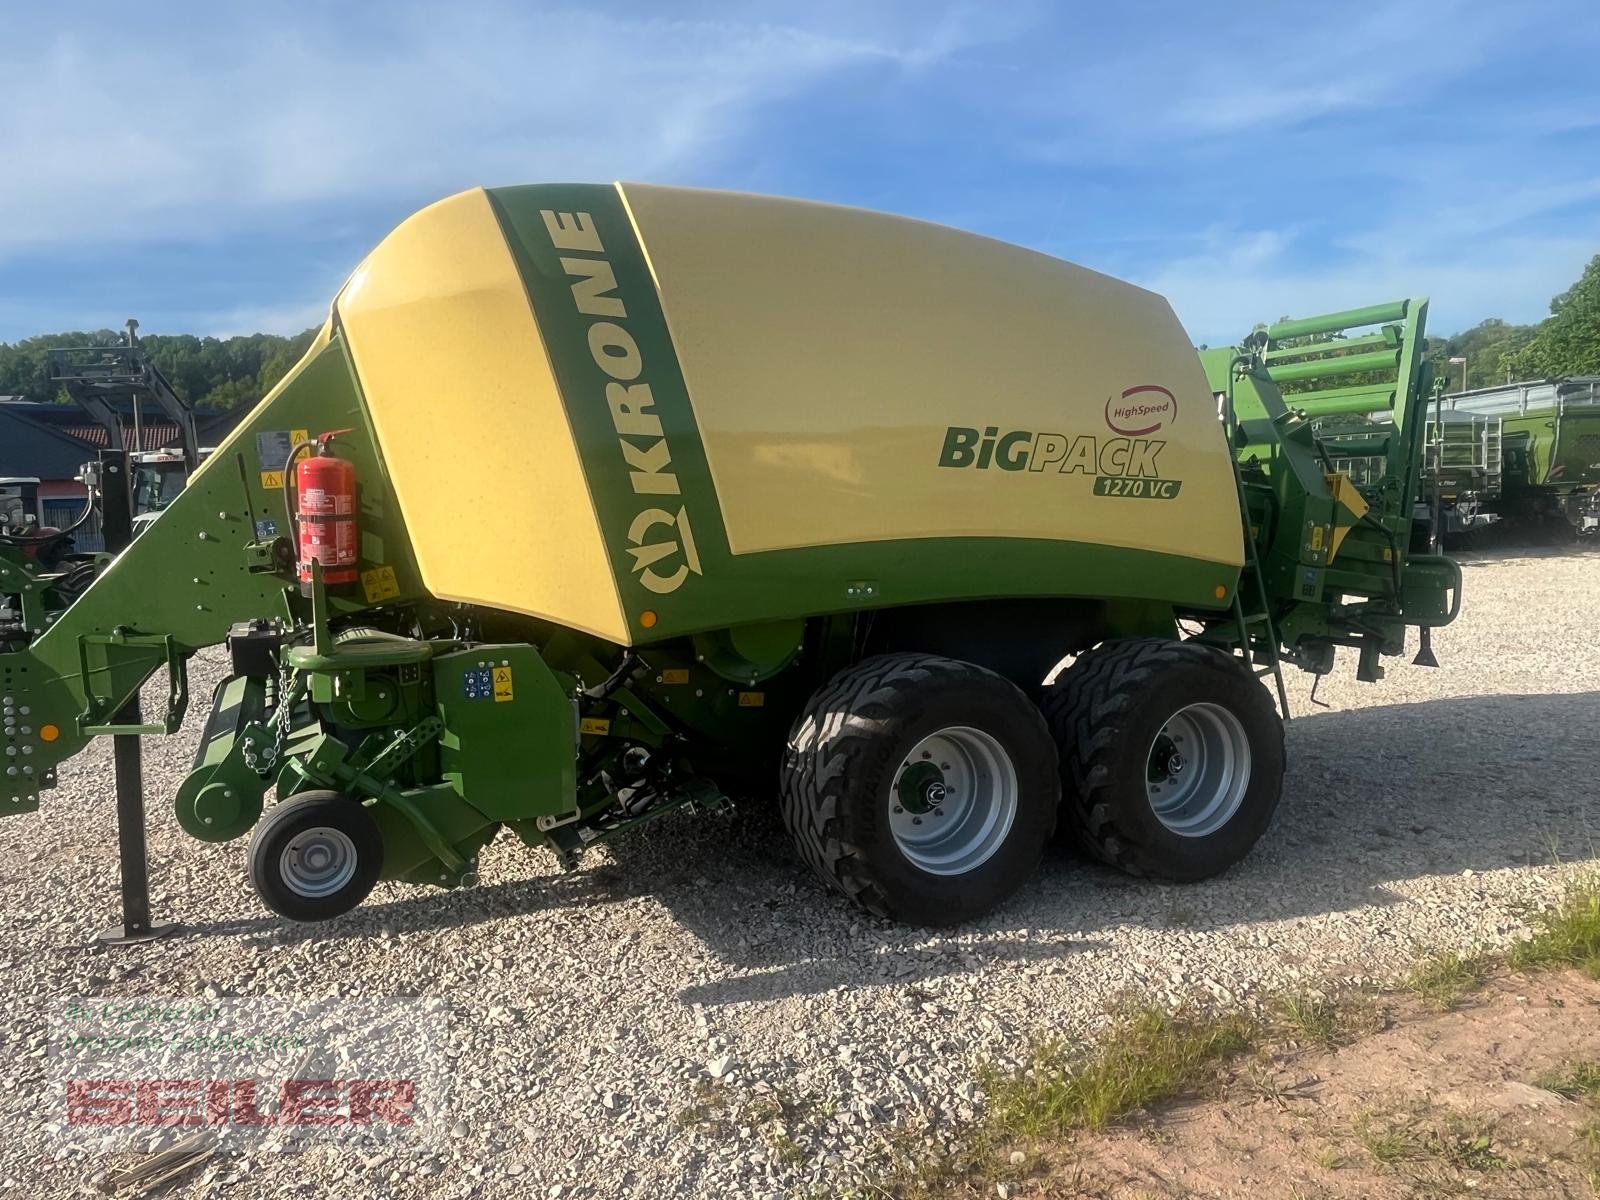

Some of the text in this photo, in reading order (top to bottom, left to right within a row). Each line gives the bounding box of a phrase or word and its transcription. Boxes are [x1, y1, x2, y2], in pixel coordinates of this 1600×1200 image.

[539, 209, 681, 495] KRONE
[1113, 401, 1169, 419] HighSpeed
[1103, 478, 1173, 498] 1270 VC
